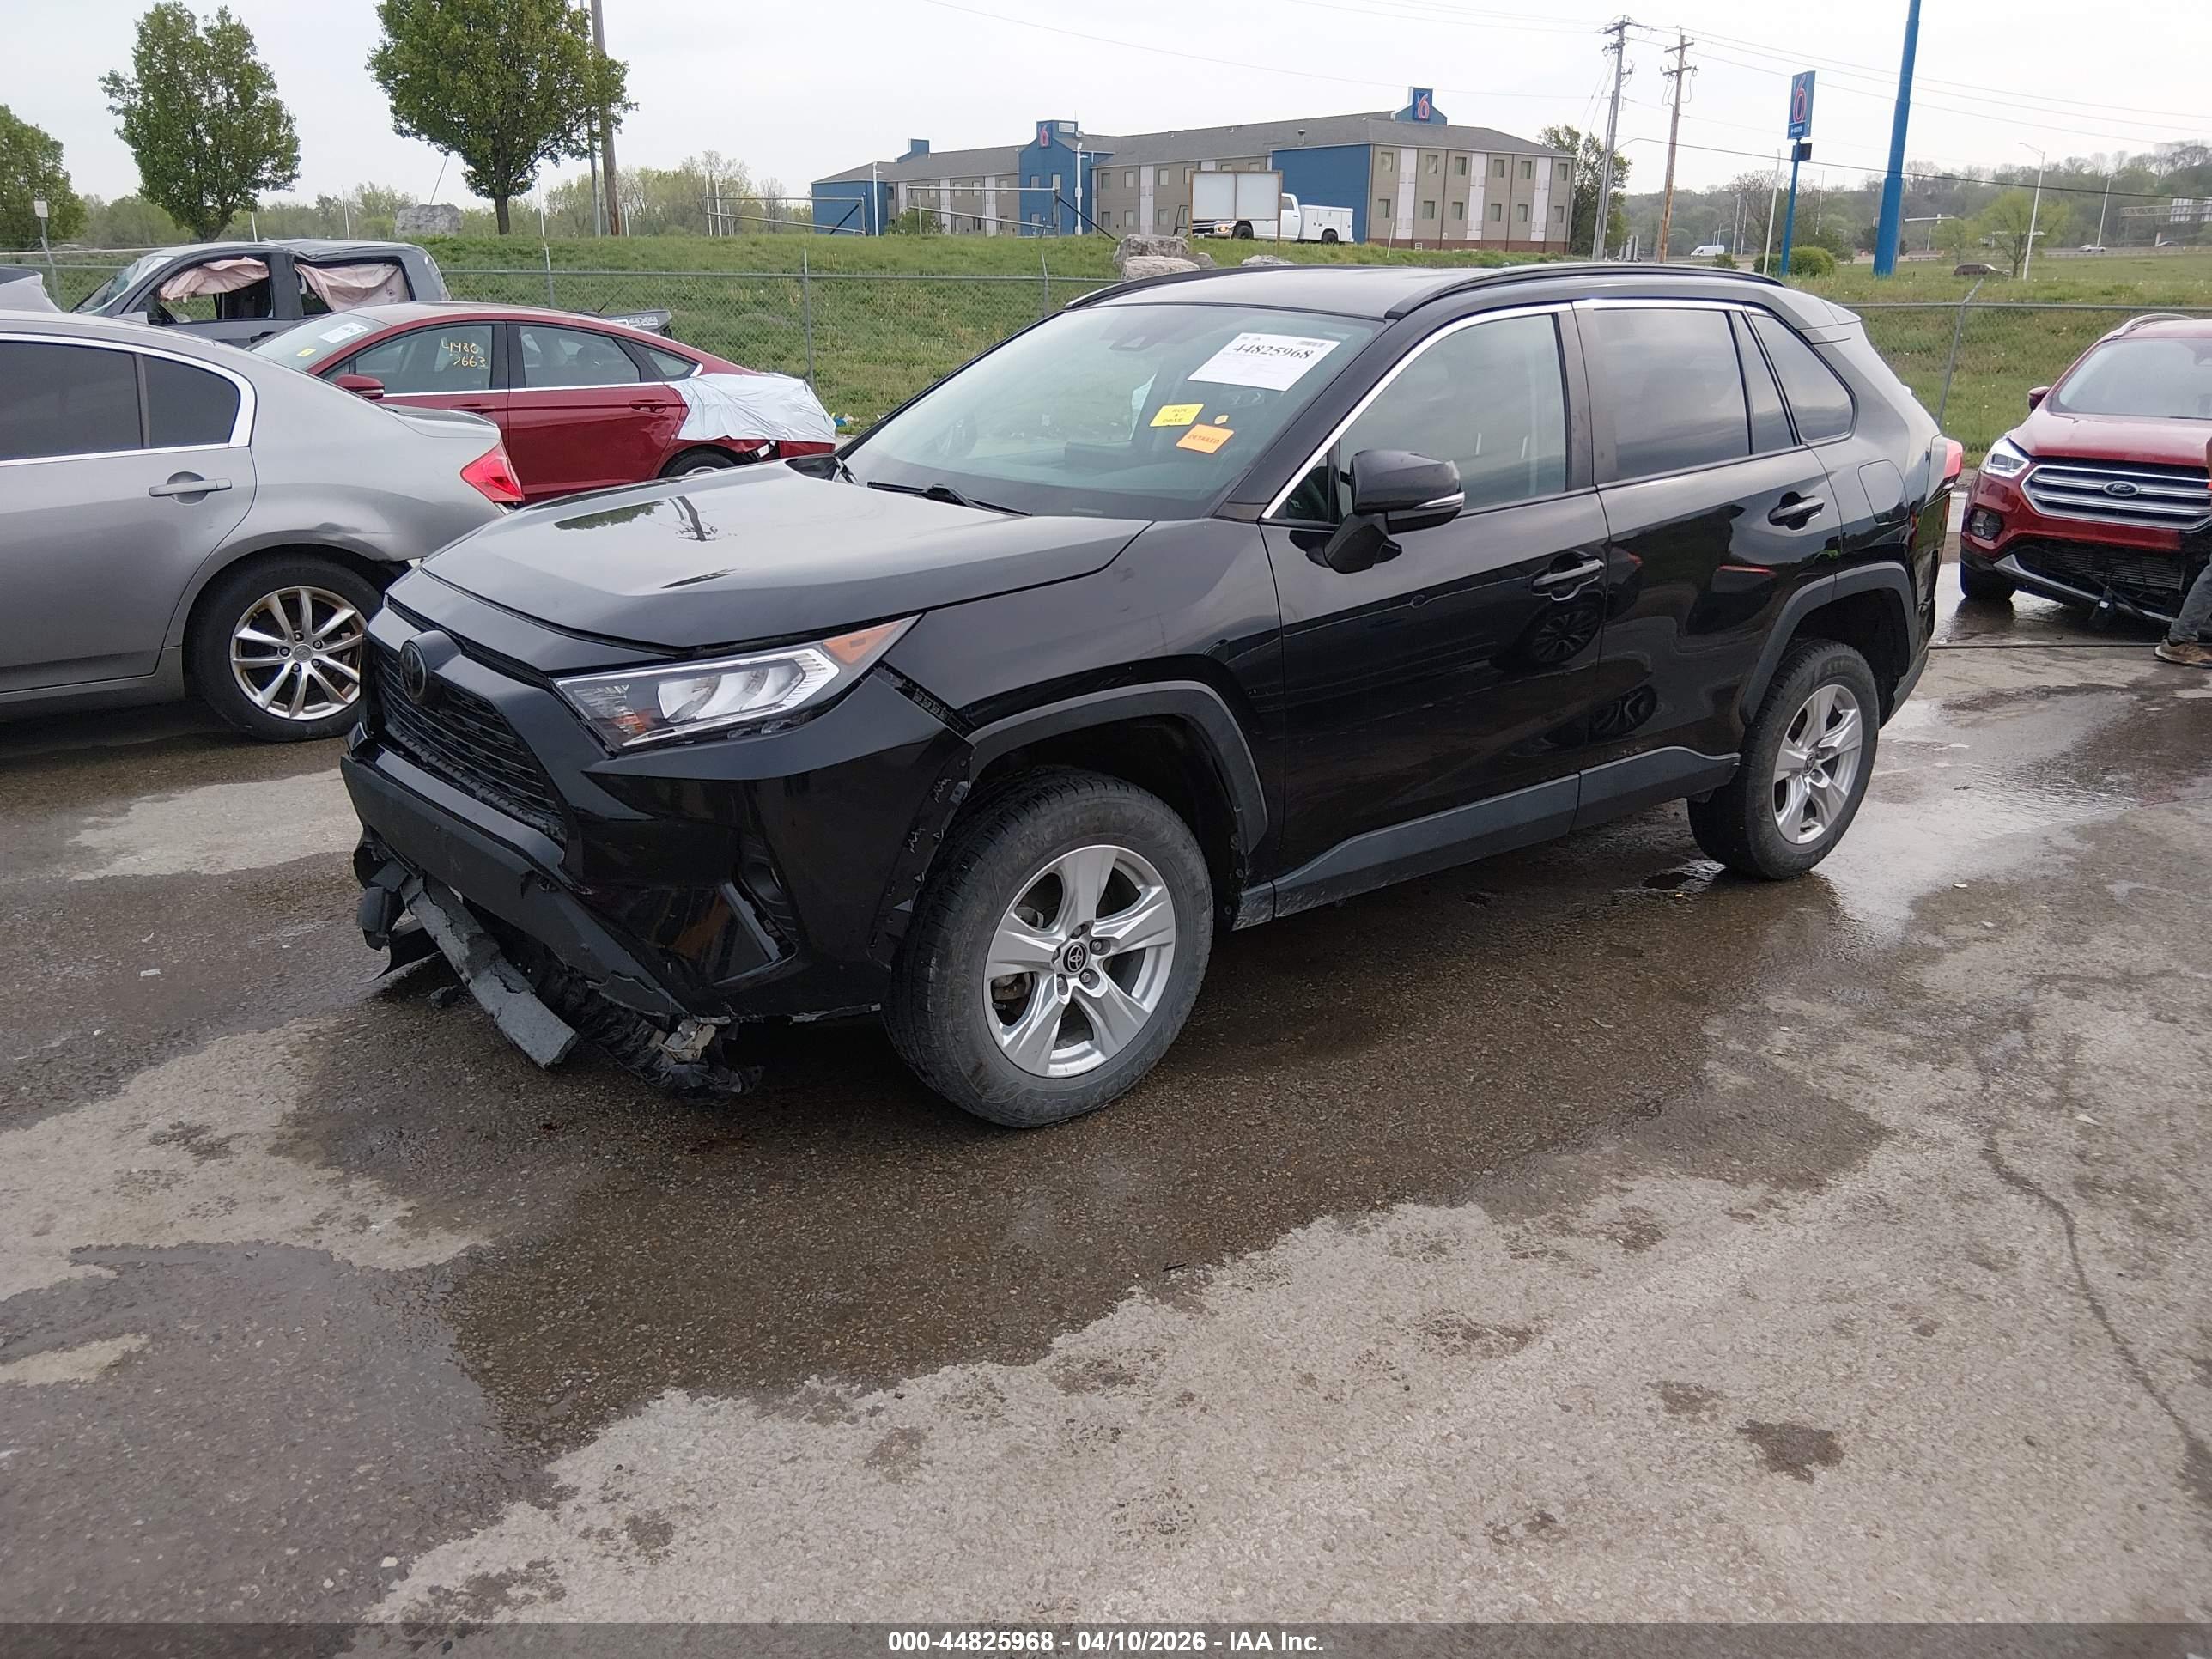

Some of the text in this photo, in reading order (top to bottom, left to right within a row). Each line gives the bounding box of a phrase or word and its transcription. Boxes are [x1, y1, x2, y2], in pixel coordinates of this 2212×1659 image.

[1418, 94, 1430, 119] 6
[1793, 74, 1807, 123] 6
[1232, 343, 1315, 359] 44825968
